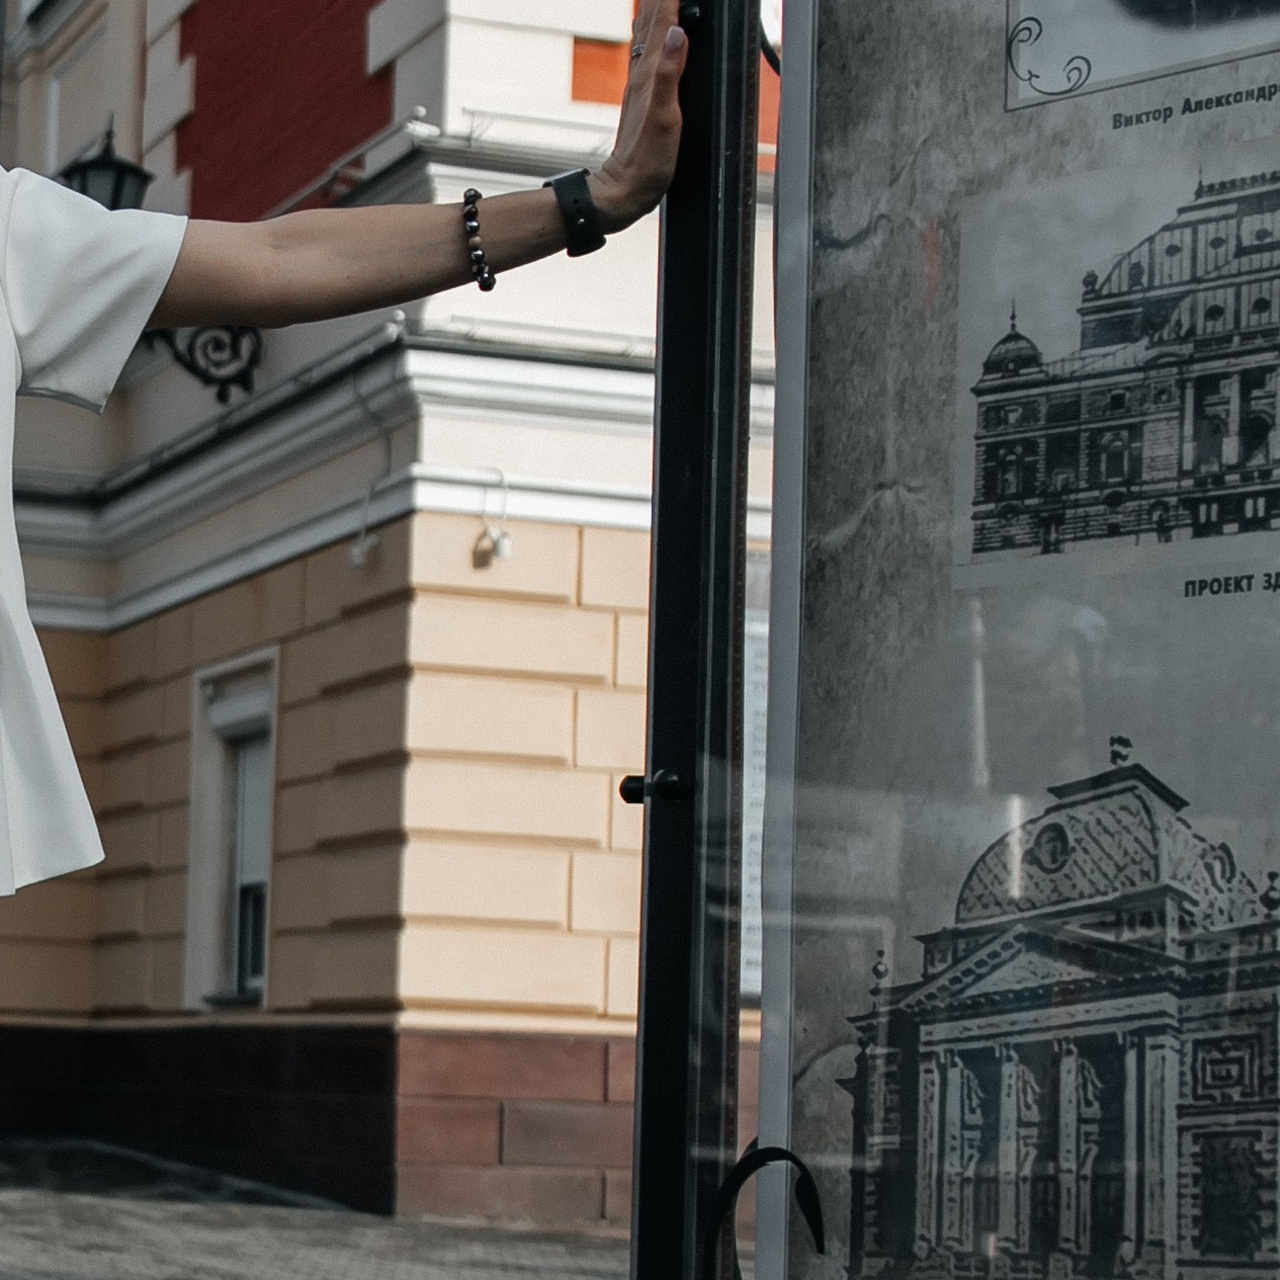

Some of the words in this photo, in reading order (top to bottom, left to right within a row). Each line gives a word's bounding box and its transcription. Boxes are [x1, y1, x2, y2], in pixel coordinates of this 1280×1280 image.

[1112, 106, 1174, 130] Виктор
[1181, 83, 1280, 116] Александр
[1184, 574, 1255, 597] ПРОЕКТ
